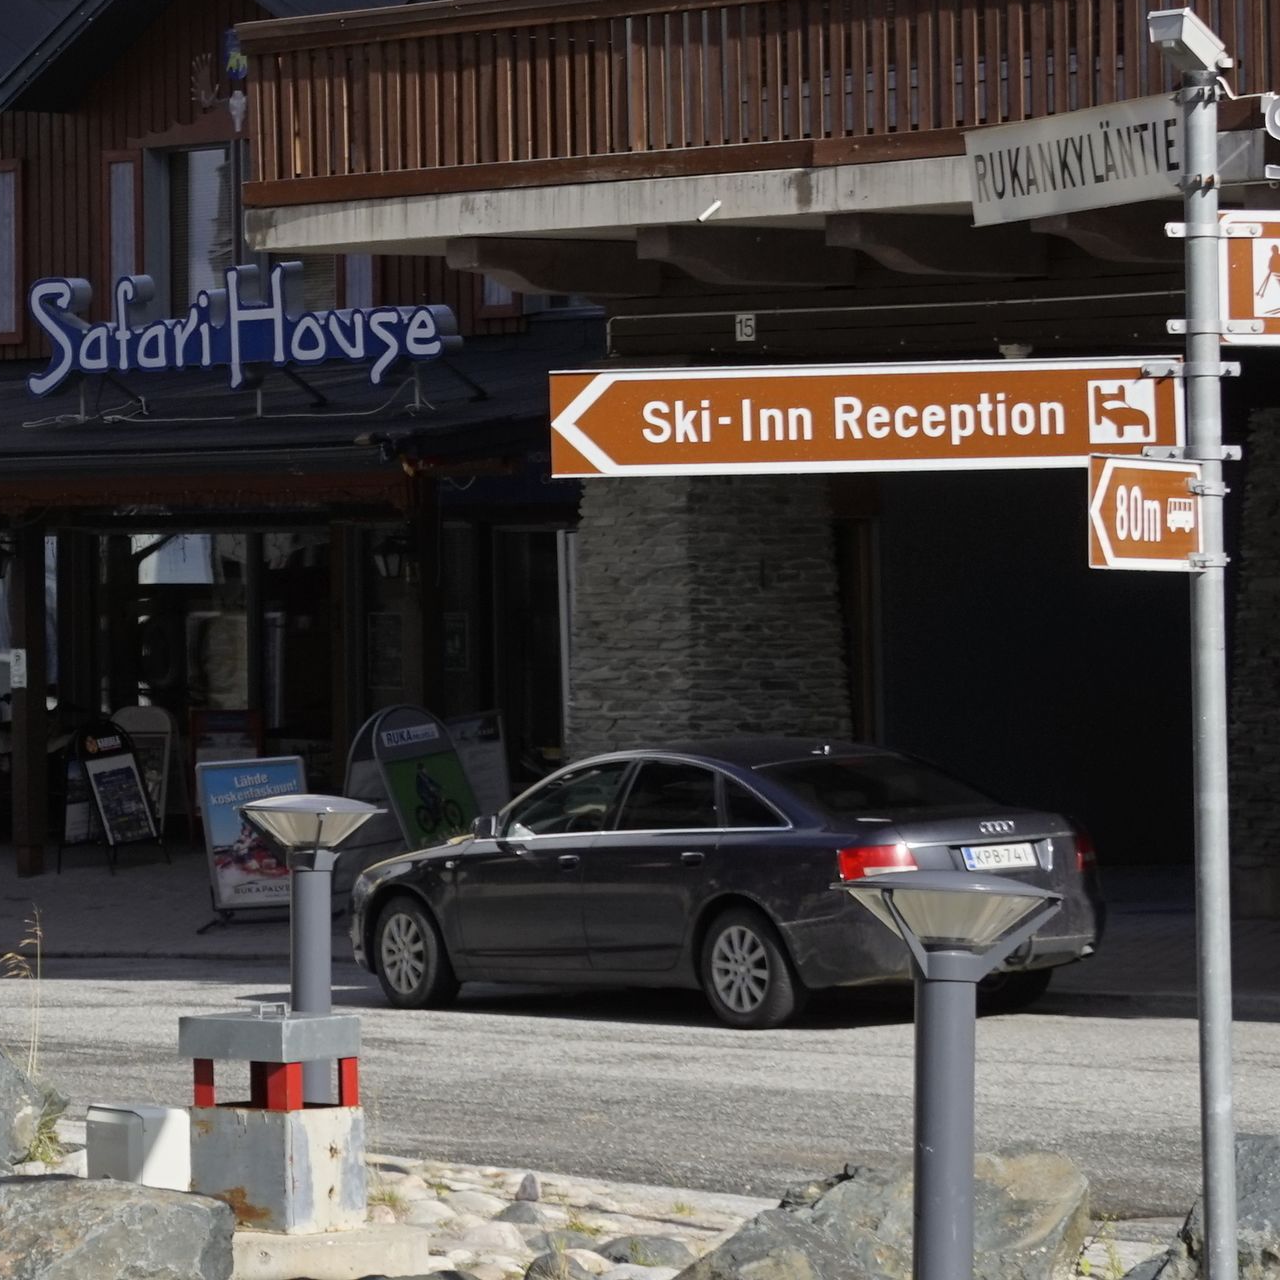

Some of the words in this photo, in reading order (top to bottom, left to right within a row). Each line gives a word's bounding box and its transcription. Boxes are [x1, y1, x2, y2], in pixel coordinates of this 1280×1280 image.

[973, 117, 1181, 204] RUKANKYLÄNTIE
[27, 280, 213, 396] Safari
[225, 263, 443, 390] House
[736, 318, 754, 338] 15
[641, 394, 815, 445] Ski-Inn
[832, 391, 1067, 447] Reception
[1114, 484, 1162, 544] 80m
[385, 730, 412, 745] RUKA
[233, 773, 269, 788] Lähde
[233, 884, 290, 895] RUKAPALVE
